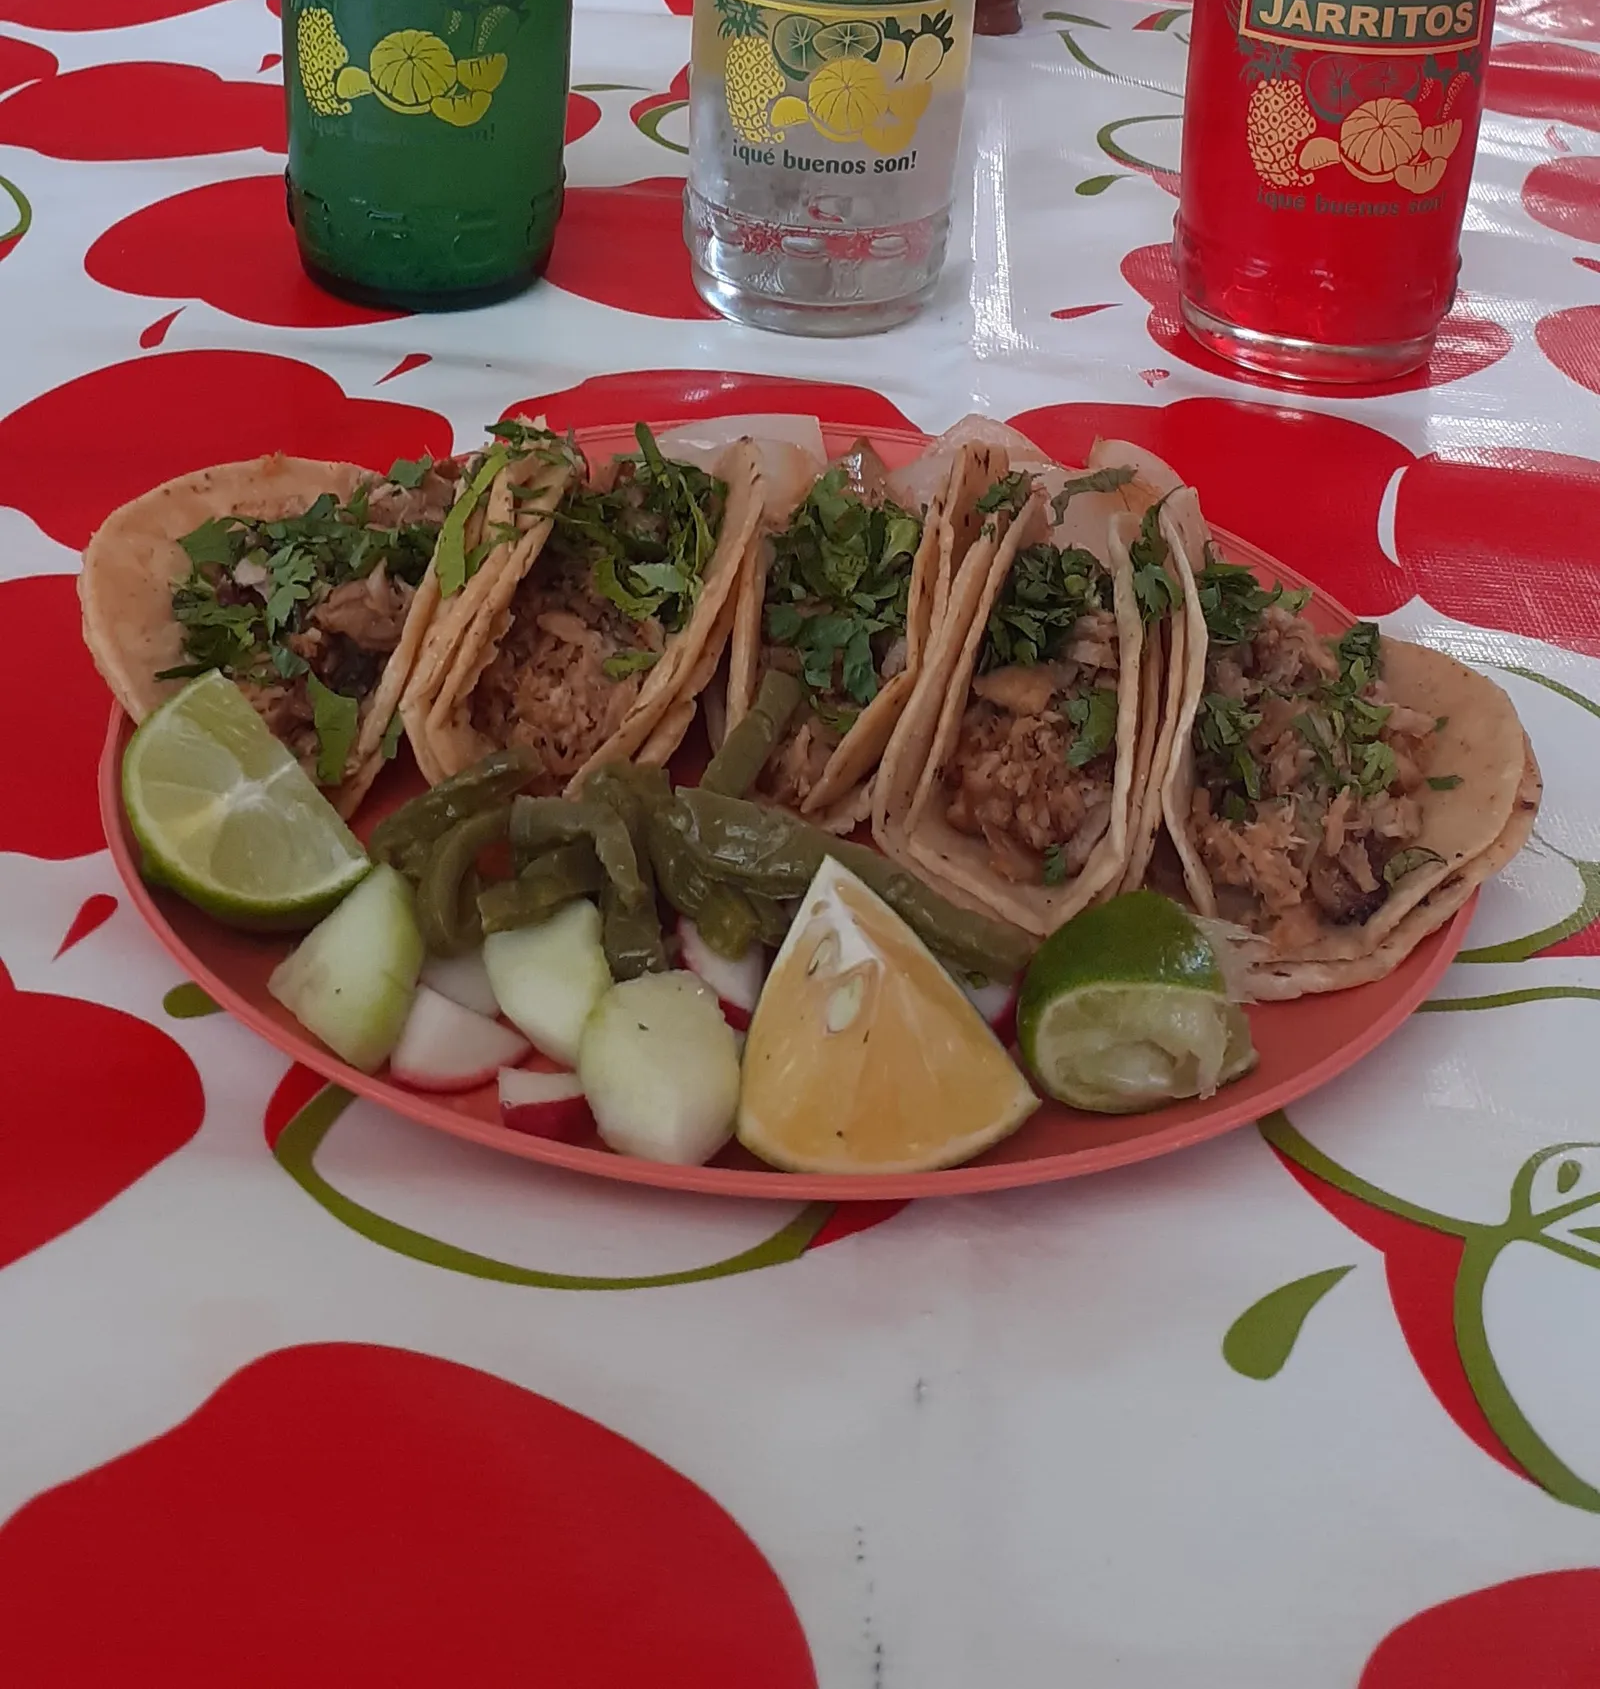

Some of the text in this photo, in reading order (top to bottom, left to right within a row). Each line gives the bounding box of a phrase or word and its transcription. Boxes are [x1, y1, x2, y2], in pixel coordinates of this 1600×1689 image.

[783, 149, 867, 175] buenos
[873, 150, 918, 174] son!
[1315, 192, 1400, 217] buenos
